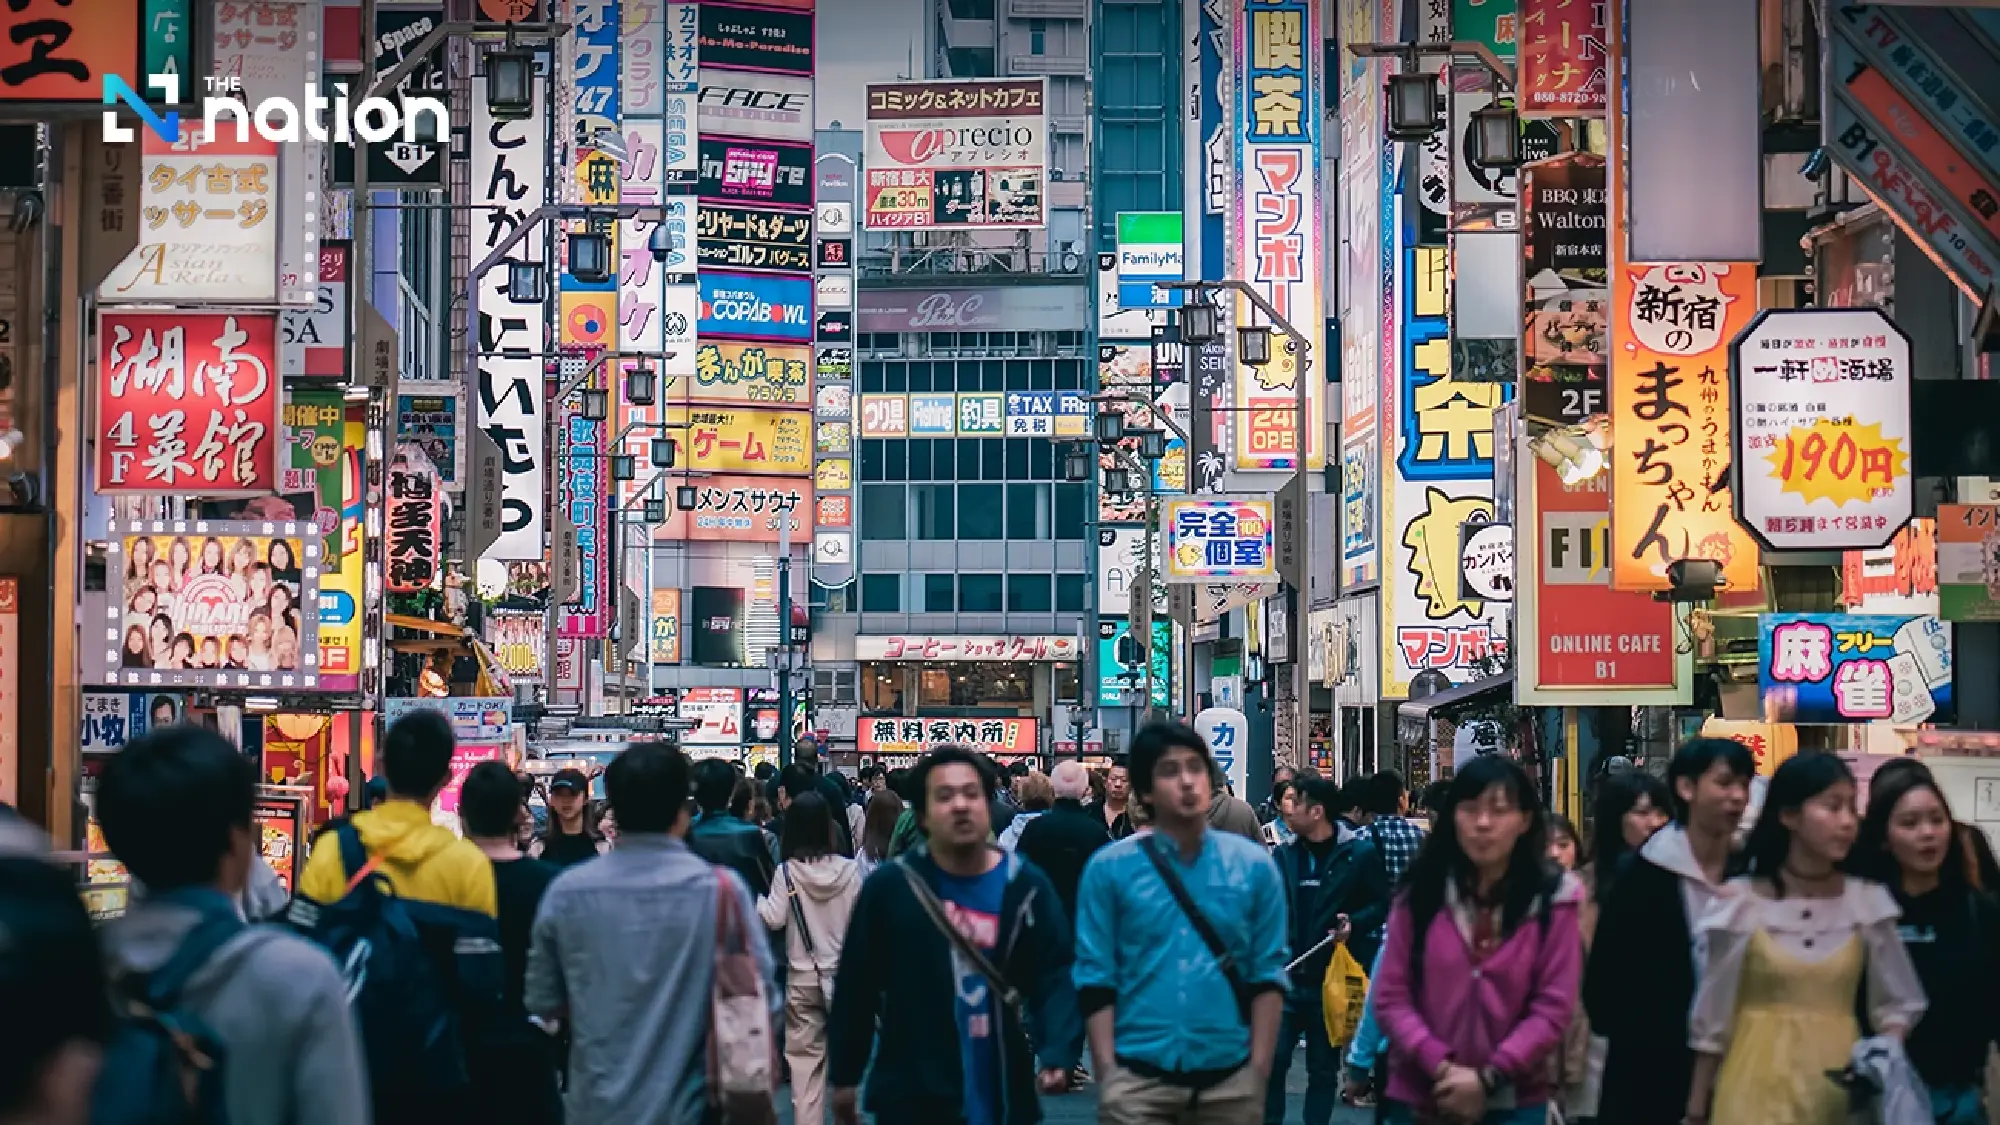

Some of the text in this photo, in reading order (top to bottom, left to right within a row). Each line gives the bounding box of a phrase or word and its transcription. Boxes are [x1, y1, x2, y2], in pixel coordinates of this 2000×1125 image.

[680, 5, 696, 80] カラオケ
[1253, 11, 1303, 136] 喫茶
[870, 87, 1042, 110] コミック&ネットカフェ
[1838, 122, 1878, 161] B1
[150, 163, 268, 194] タイ古式
[1542, 189, 1579, 204] BBQ
[727, 244, 767, 266] ゴルフ
[1554, 244, 1603, 257] 新宿本店
[1635, 284, 1719, 330] 新宿
[1665, 330, 1693, 351] の
[697, 345, 807, 387] まんが喫茶
[864, 399, 905, 431] つり具
[962, 398, 1002, 431] 釣具
[1024, 395, 1053, 413] TAX
[1561, 389, 1600, 415] 2F
[693, 428, 766, 461] ゲーム
[1780, 431, 1893, 484] 190円
[1632, 361, 1696, 562] まっちゃん
[696, 486, 802, 514] メンズサウナ
[1177, 510, 1236, 538] 完全
[1205, 540, 1264, 567] 個室
[884, 636, 957, 659] コーヒー
[1551, 635, 1662, 653] ONLINE CAFE
[1835, 631, 1893, 653] フリー
[1594, 662, 1617, 679] B1
[872, 719, 1006, 743] 無料案内所
